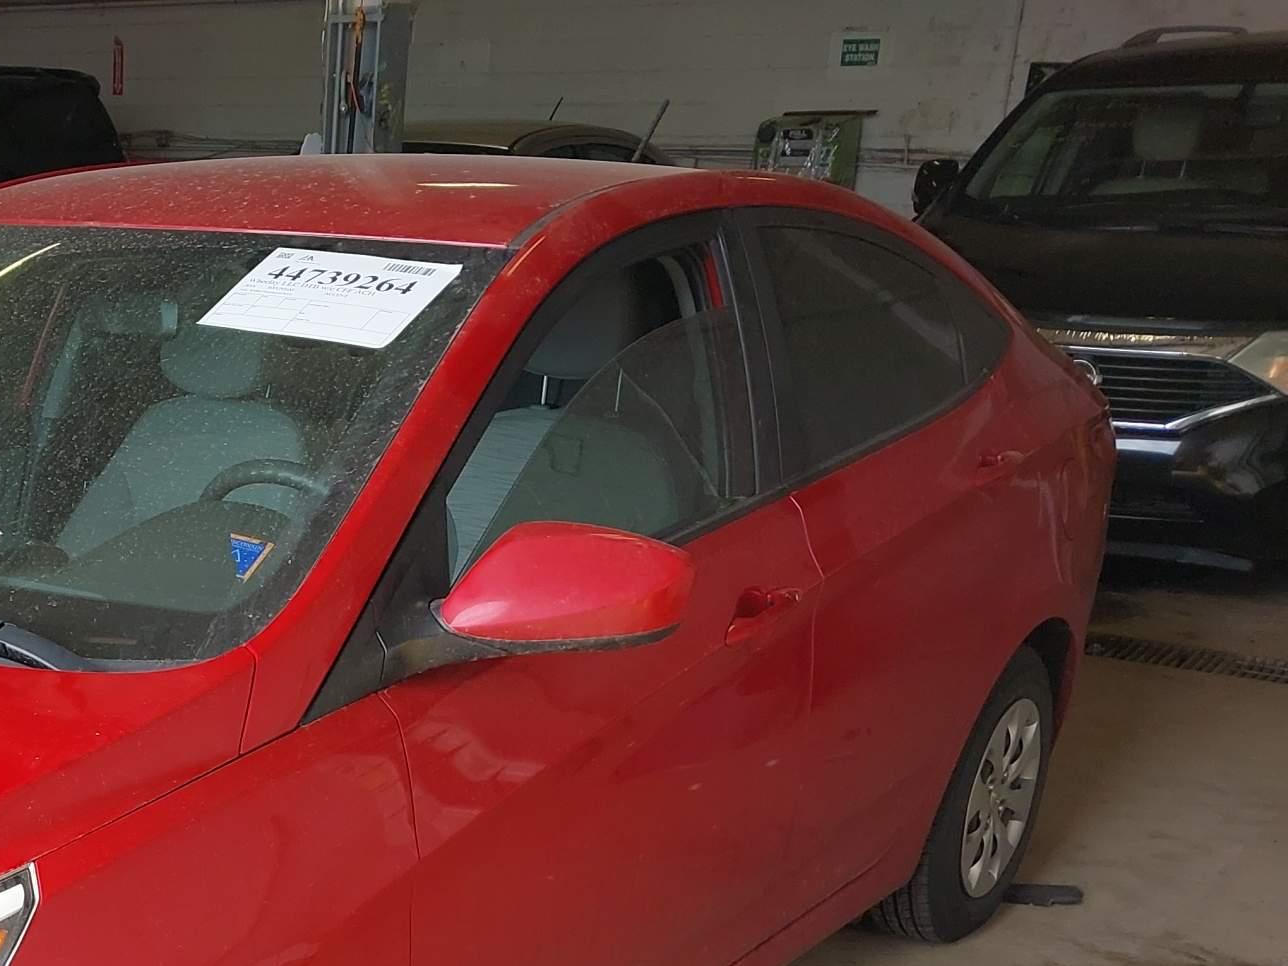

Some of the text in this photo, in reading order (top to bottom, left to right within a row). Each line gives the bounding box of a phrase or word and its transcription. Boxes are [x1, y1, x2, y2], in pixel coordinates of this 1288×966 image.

[843, 43, 879, 52] EYE WASH
[844, 53, 875, 62] STATION
[268, 266, 418, 295] 44739264
